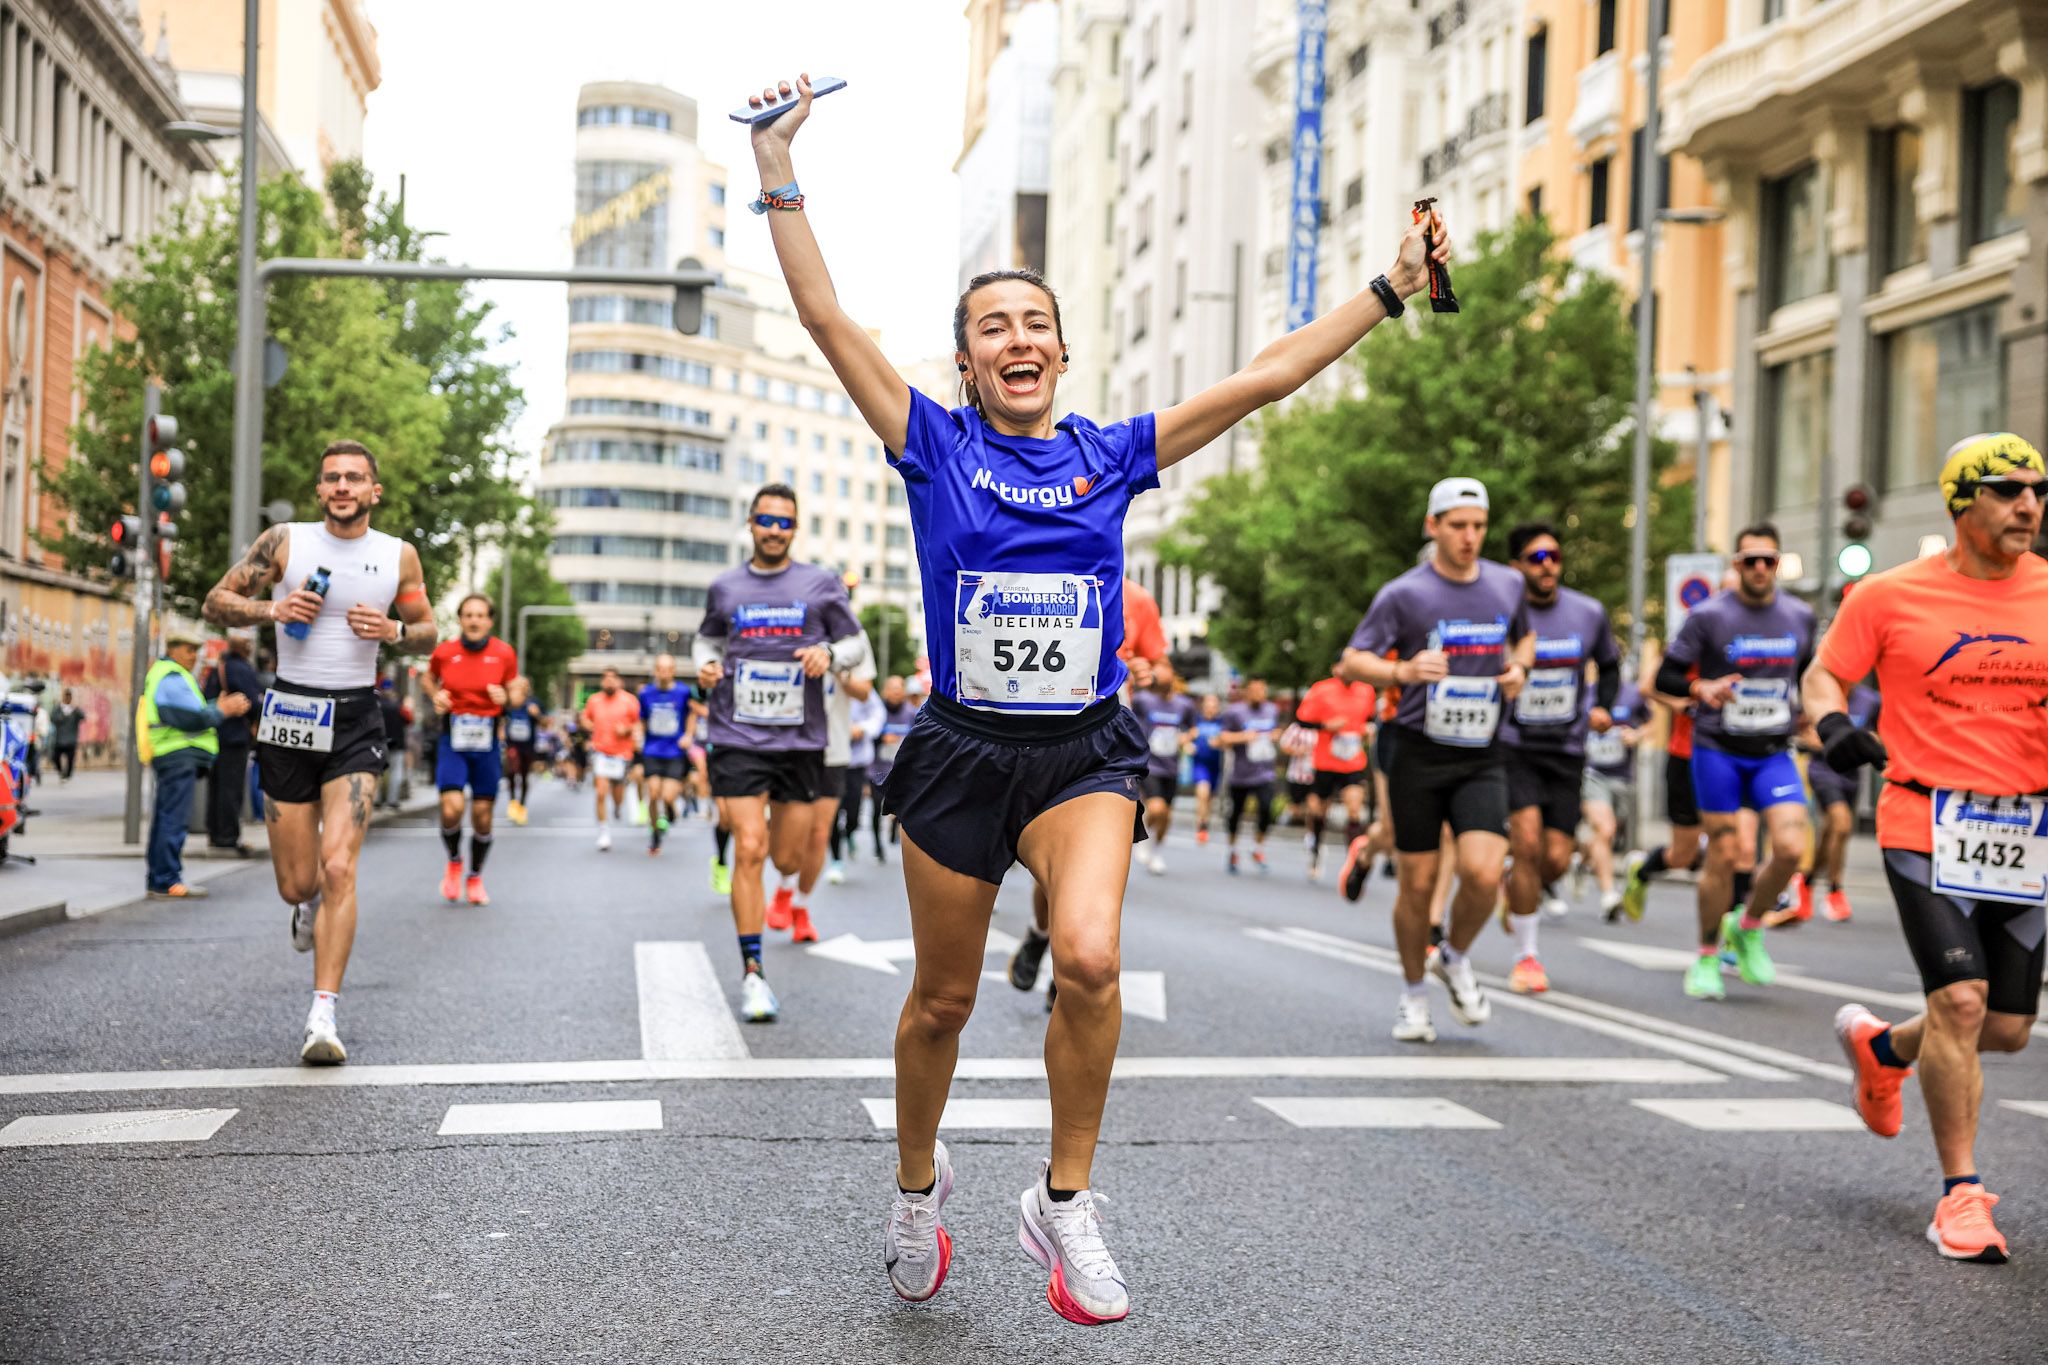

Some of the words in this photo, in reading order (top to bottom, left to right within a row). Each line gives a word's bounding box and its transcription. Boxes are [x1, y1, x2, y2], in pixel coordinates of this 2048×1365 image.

[1002, 592, 1076, 605] BOMBEROS
[1031, 604, 1041, 615] de
[1043, 603, 1076, 615] MADRID
[994, 617, 1074, 629] DECIMAS
[993, 639, 1067, 673] 526
[1978, 661, 2048, 671] BRAZAD
[749, 690, 788, 706] 1197
[269, 725, 315, 749] 1854
[1966, 821, 2030, 836] DECIMAS
[1956, 838, 2026, 869] 1432
